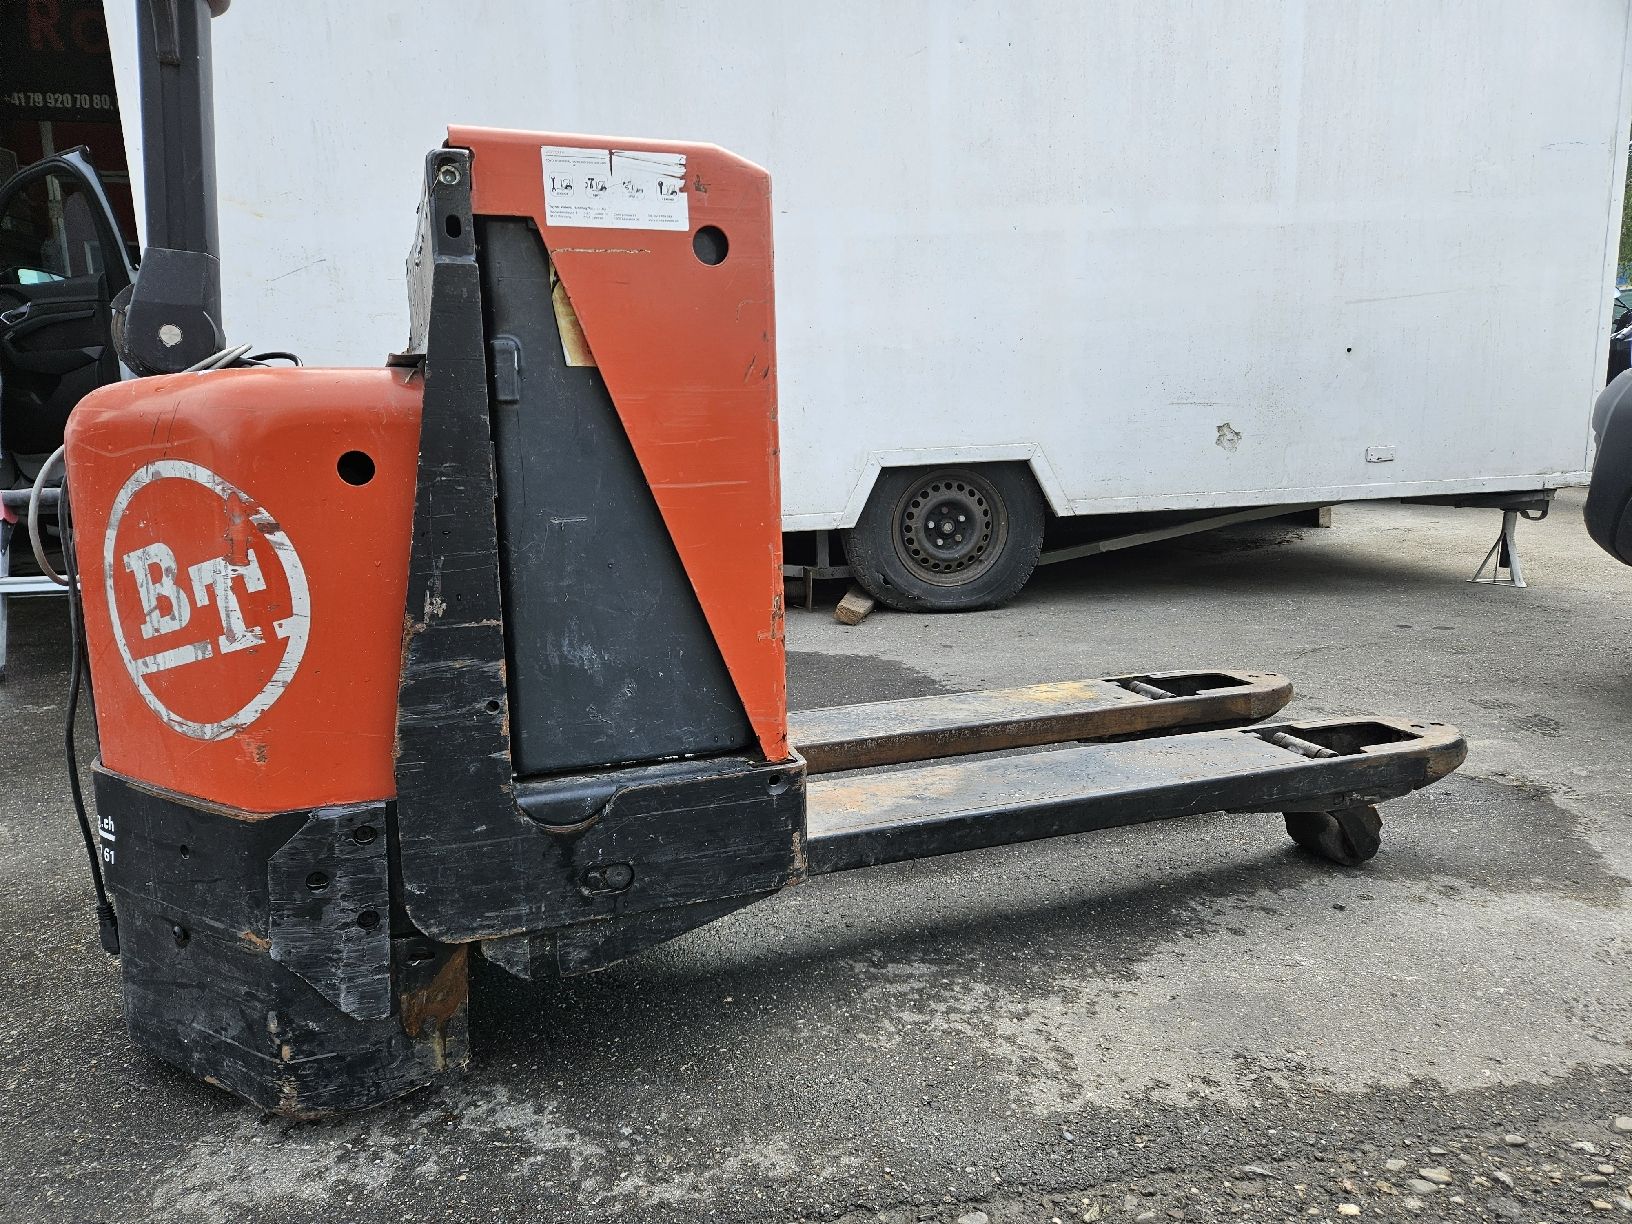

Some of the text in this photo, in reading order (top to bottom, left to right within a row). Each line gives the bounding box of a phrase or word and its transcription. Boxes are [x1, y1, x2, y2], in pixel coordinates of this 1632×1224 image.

[4, 92, 26, 106] +41
[27, 93, 44, 107] 79
[46, 93, 72, 108] 920
[73, 93, 90, 109] 70
[123, 542, 266, 654] BT
